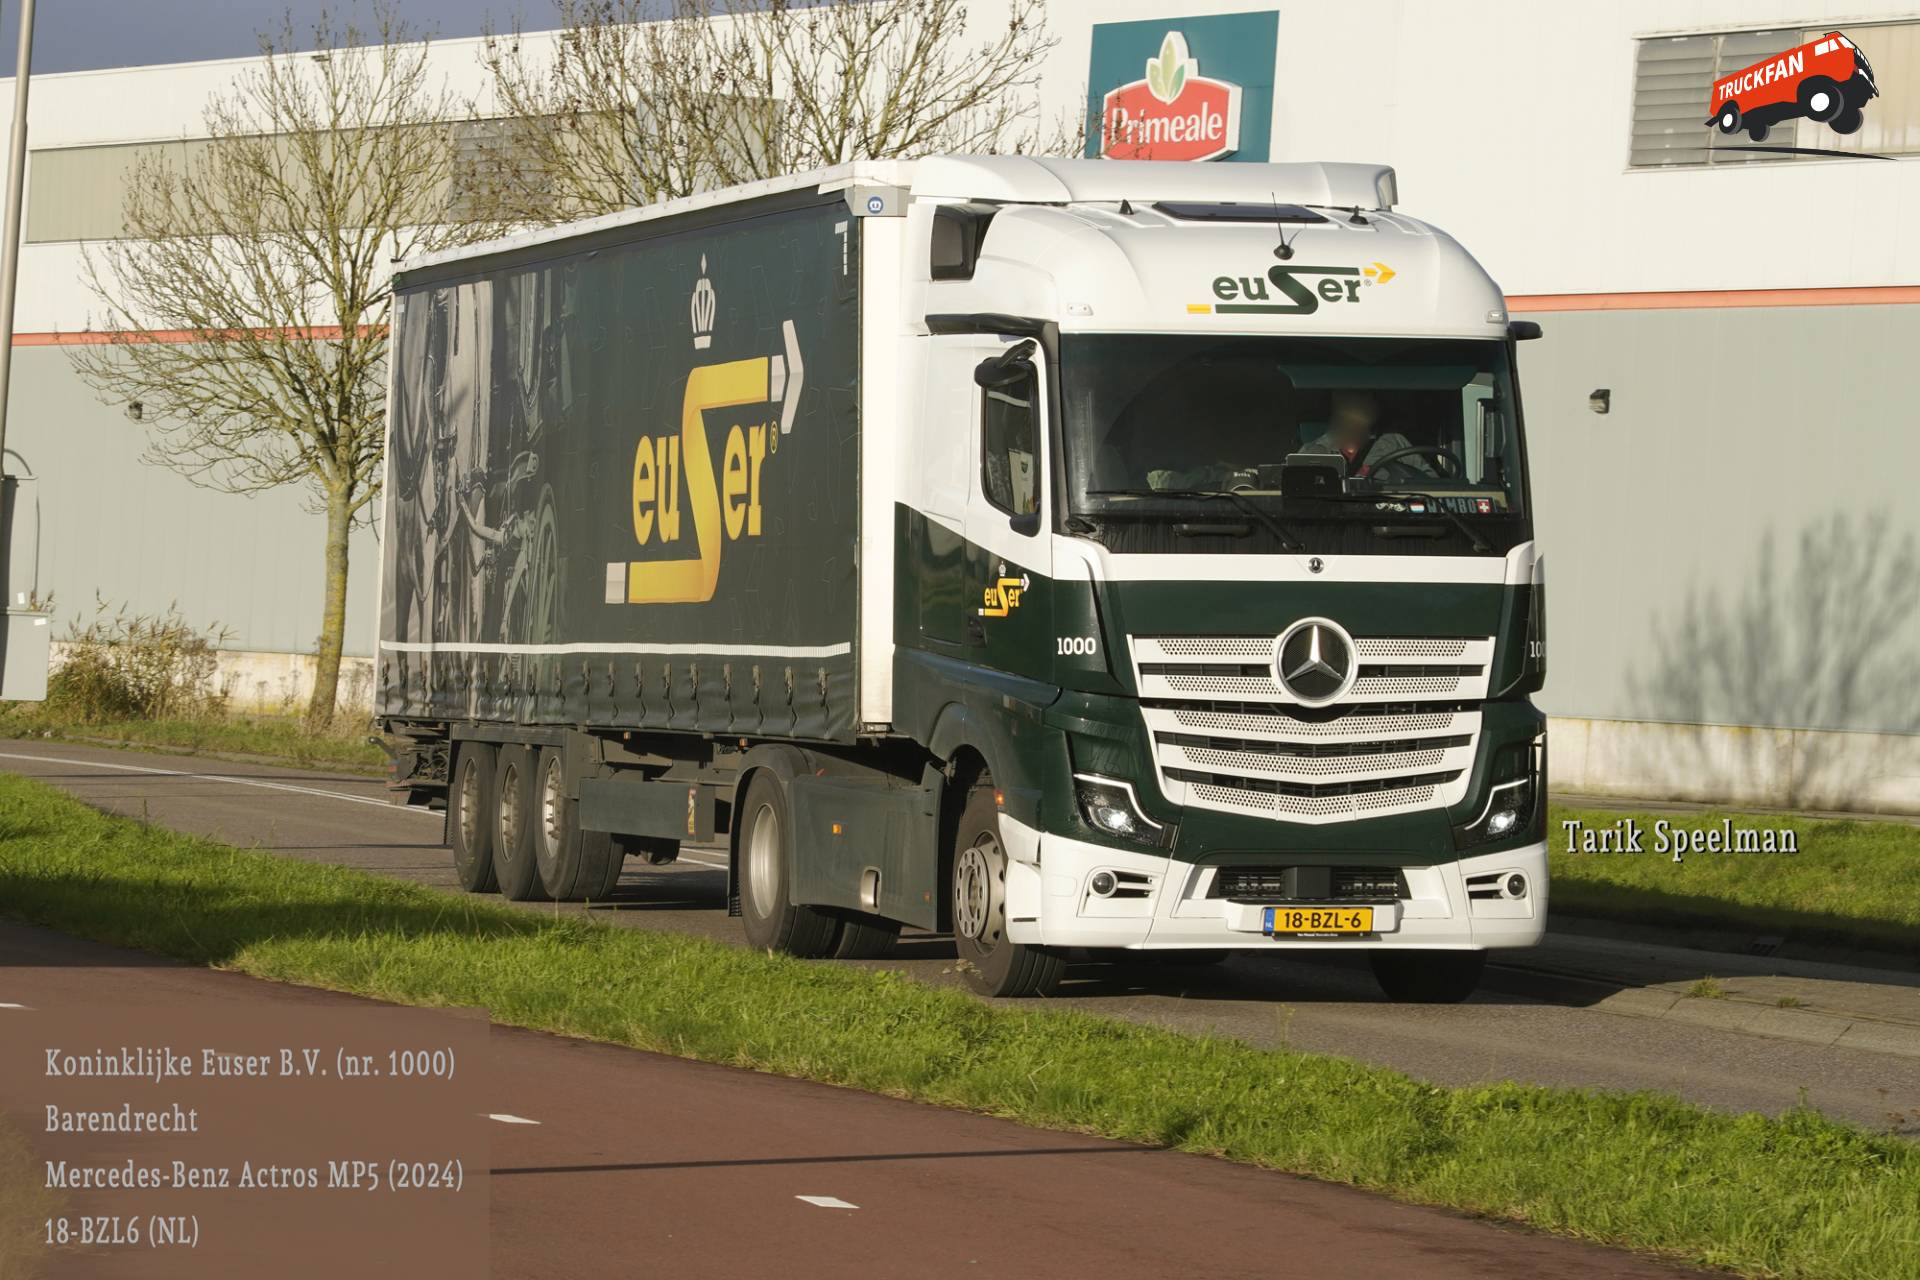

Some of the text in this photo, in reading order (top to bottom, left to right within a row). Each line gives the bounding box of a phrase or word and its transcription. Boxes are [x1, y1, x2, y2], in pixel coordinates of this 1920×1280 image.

[1112, 101, 1223, 145] Primeale
[1057, 637, 1096, 655] 1000
[1284, 911, 1362, 929] 18-BZL-6
